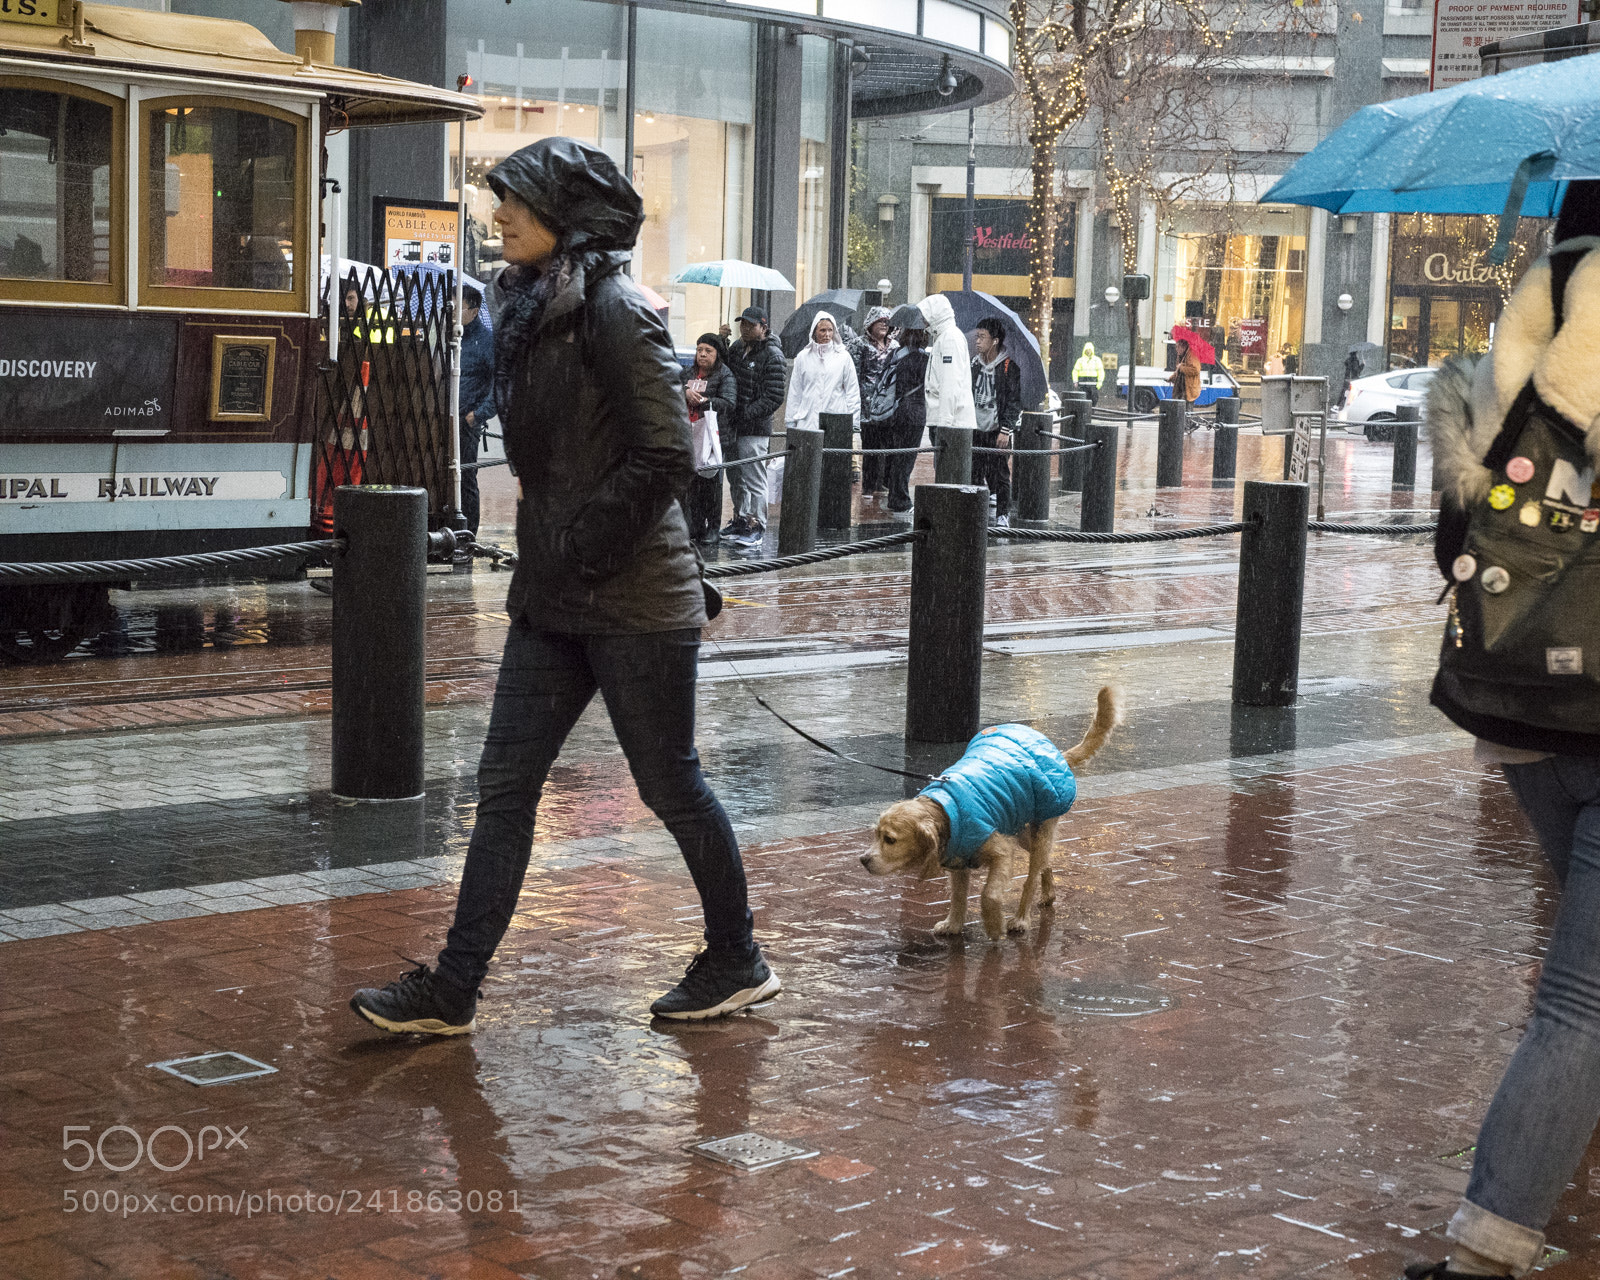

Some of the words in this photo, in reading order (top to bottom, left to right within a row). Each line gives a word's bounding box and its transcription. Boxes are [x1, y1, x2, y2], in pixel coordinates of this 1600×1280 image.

[1490, 4, 1524, 12] PAYMENT
[388, 218, 427, 230] CABLE
[430, 221, 455, 231] CAR
[1185, 319, 1210, 327] SLE
[0, 359, 97, 379] DISCOVERY
[104, 406, 154, 416] ADIMAB
[0, 478, 68, 499] IPAL
[97, 477, 219, 498] RAILWAY
